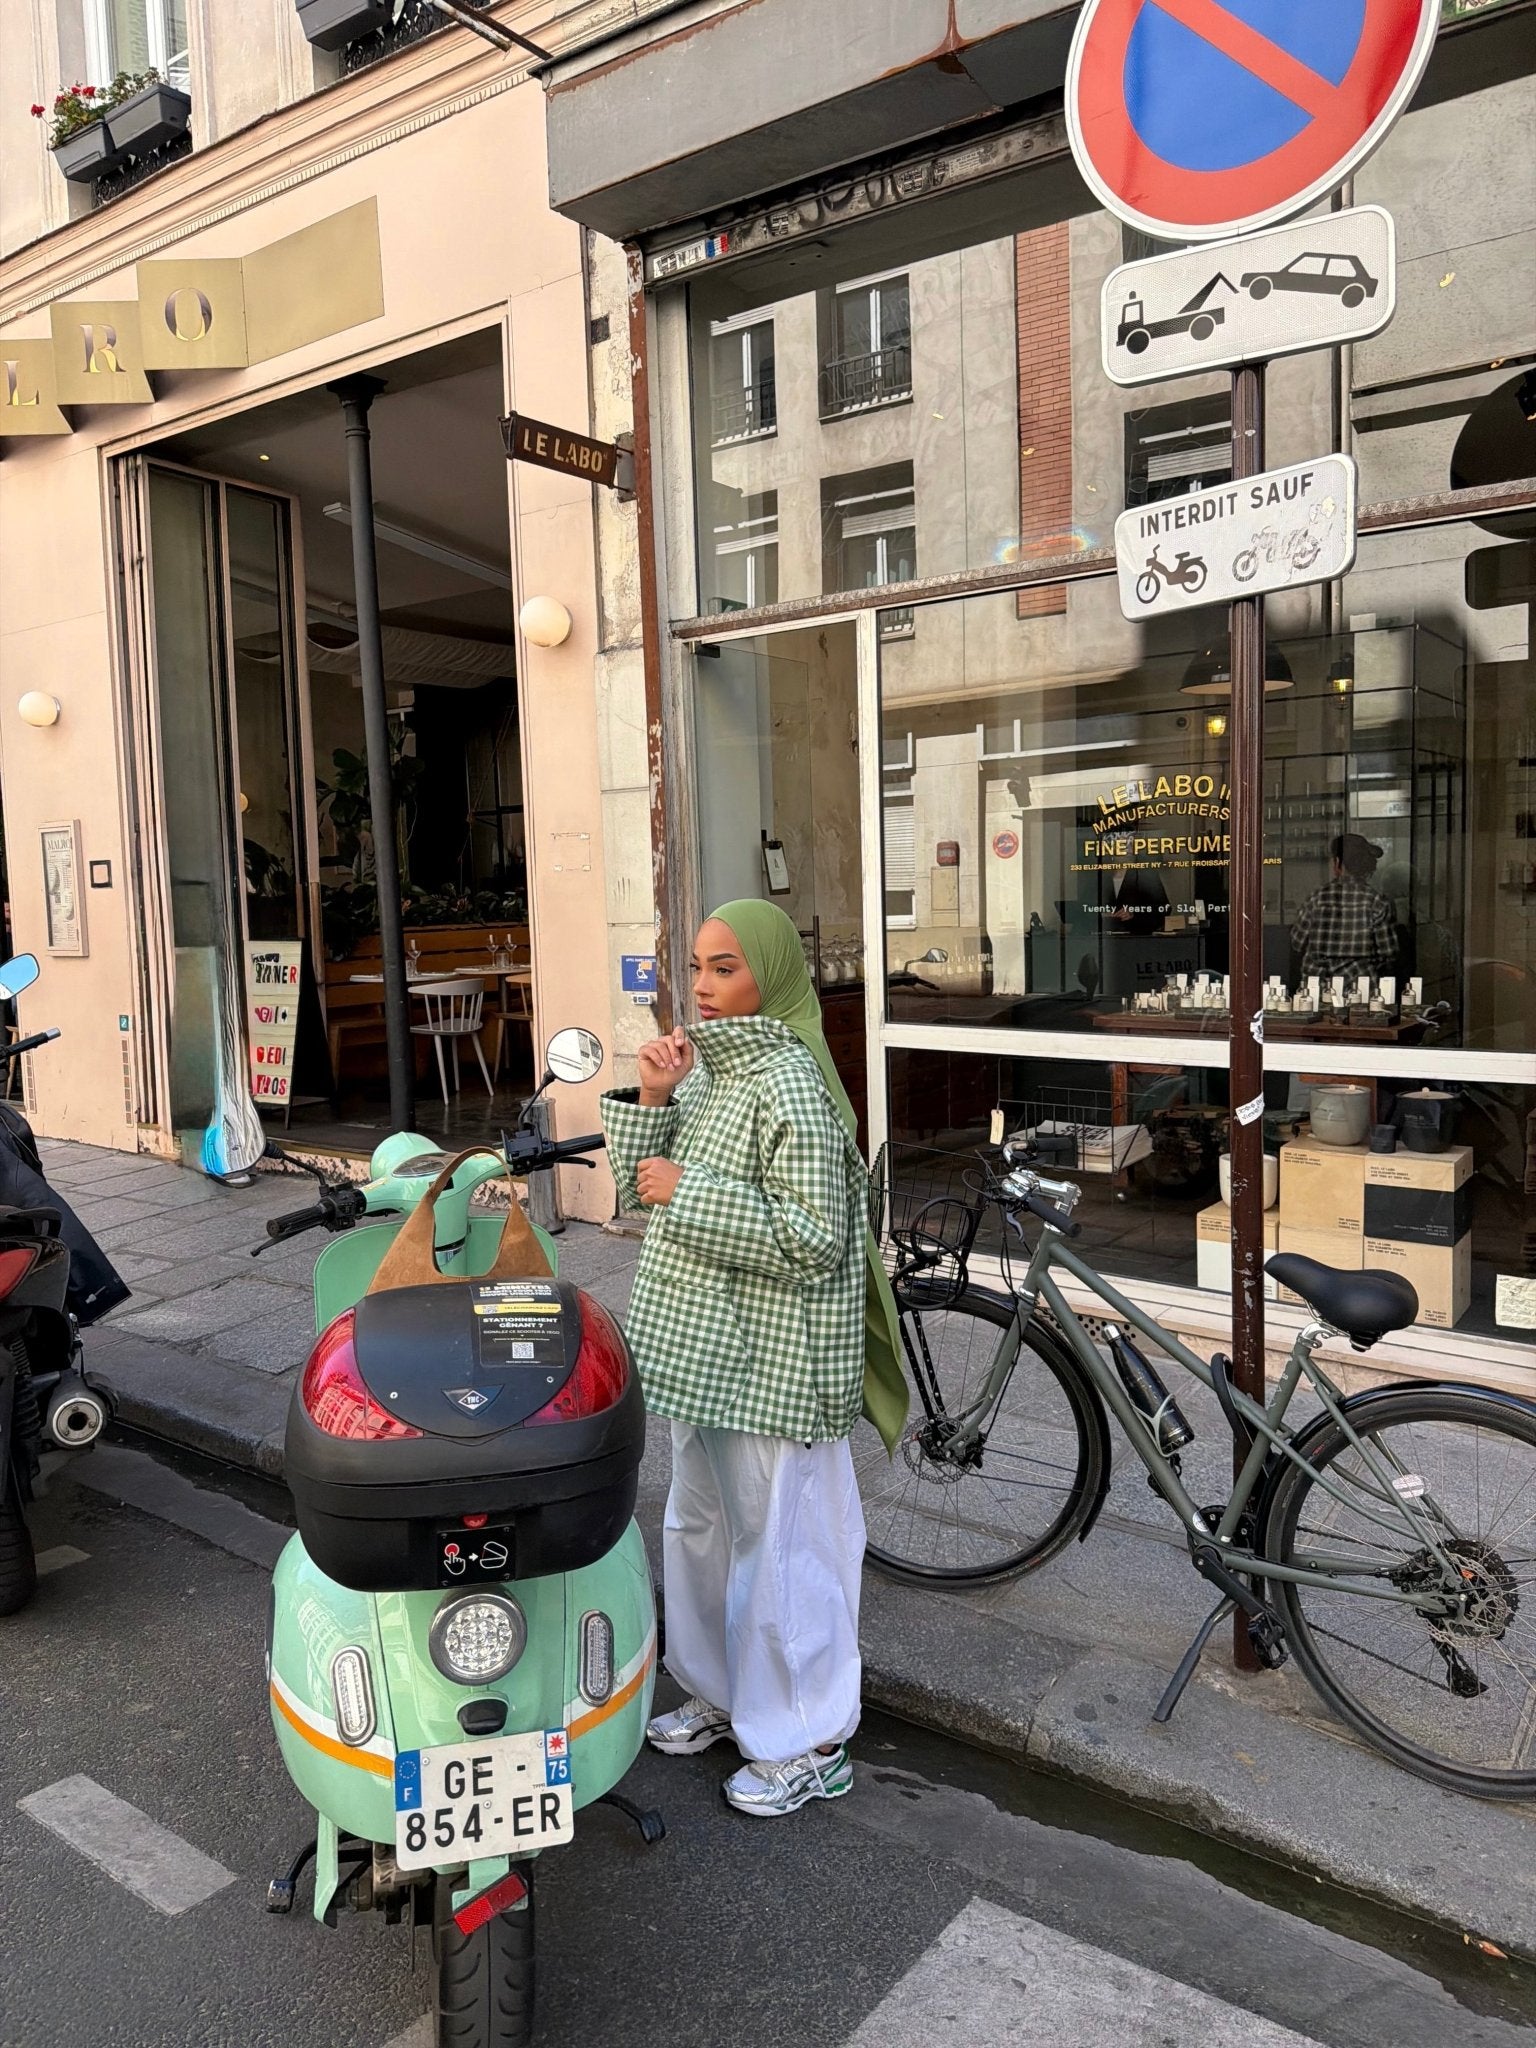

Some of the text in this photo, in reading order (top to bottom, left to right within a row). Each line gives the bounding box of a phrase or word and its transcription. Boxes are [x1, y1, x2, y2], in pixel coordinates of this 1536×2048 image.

[523, 428, 603, 473] LE LABO
[1140, 472, 1314, 538] INTERDIT SAUF
[1096, 785, 1131, 815] LE
[1138, 774, 1215, 801] LABO
[1092, 802, 1231, 834] MANUFACTURERS
[1084, 840, 1128, 857] FINE
[1083, 863, 1121, 871] ELIZABETH
[1082, 904, 1117, 914] Twenty
[1122, 904, 1152, 913] Years
[1158, 904, 1171, 913] of
[444, 1756, 494, 1799] GE
[549, 1759, 568, 1780] 75
[403, 1787, 414, 1802] F
[406, 1792, 561, 1852] 854-ER
